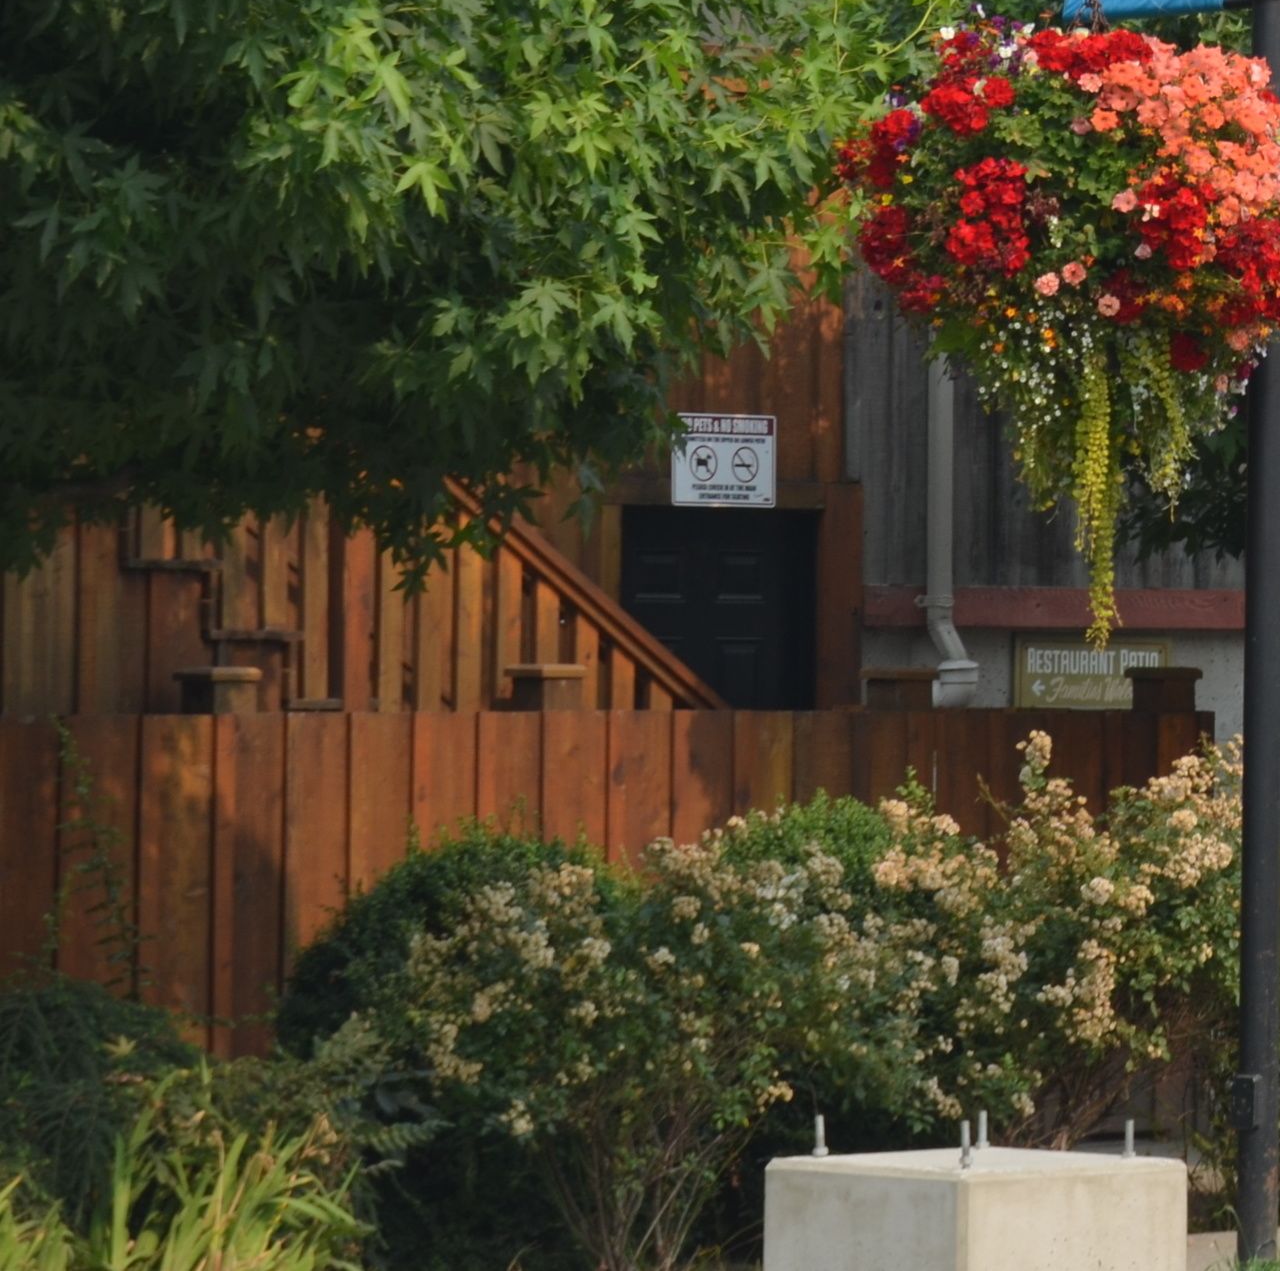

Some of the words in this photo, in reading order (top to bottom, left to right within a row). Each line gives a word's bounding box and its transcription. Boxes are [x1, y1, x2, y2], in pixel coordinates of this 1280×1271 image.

[693, 417, 713, 433] PETS
[720, 418, 732, 433] NO
[732, 419, 768, 434] SMOKING
[1027, 647, 1116, 675] RESTAURANT
[1120, 649, 1159, 675] PATIO
